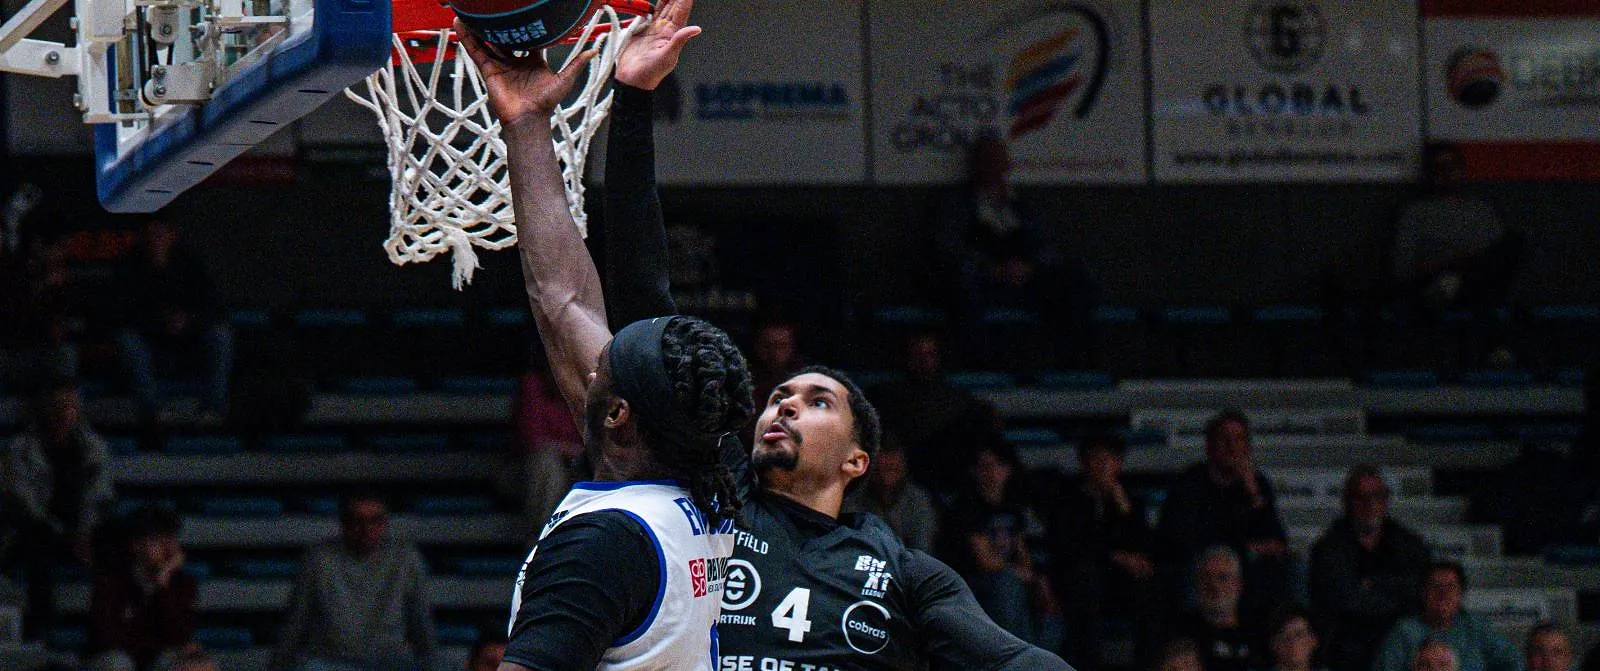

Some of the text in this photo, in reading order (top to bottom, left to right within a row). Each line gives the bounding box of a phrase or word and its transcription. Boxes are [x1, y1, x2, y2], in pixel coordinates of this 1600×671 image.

[1202, 82, 1371, 115] GLOBAL
[720, 614, 757, 626] RTRIJK
[771, 587, 812, 643] 4
[848, 620, 887, 639] cobras
[718, 655, 754, 671] SE
